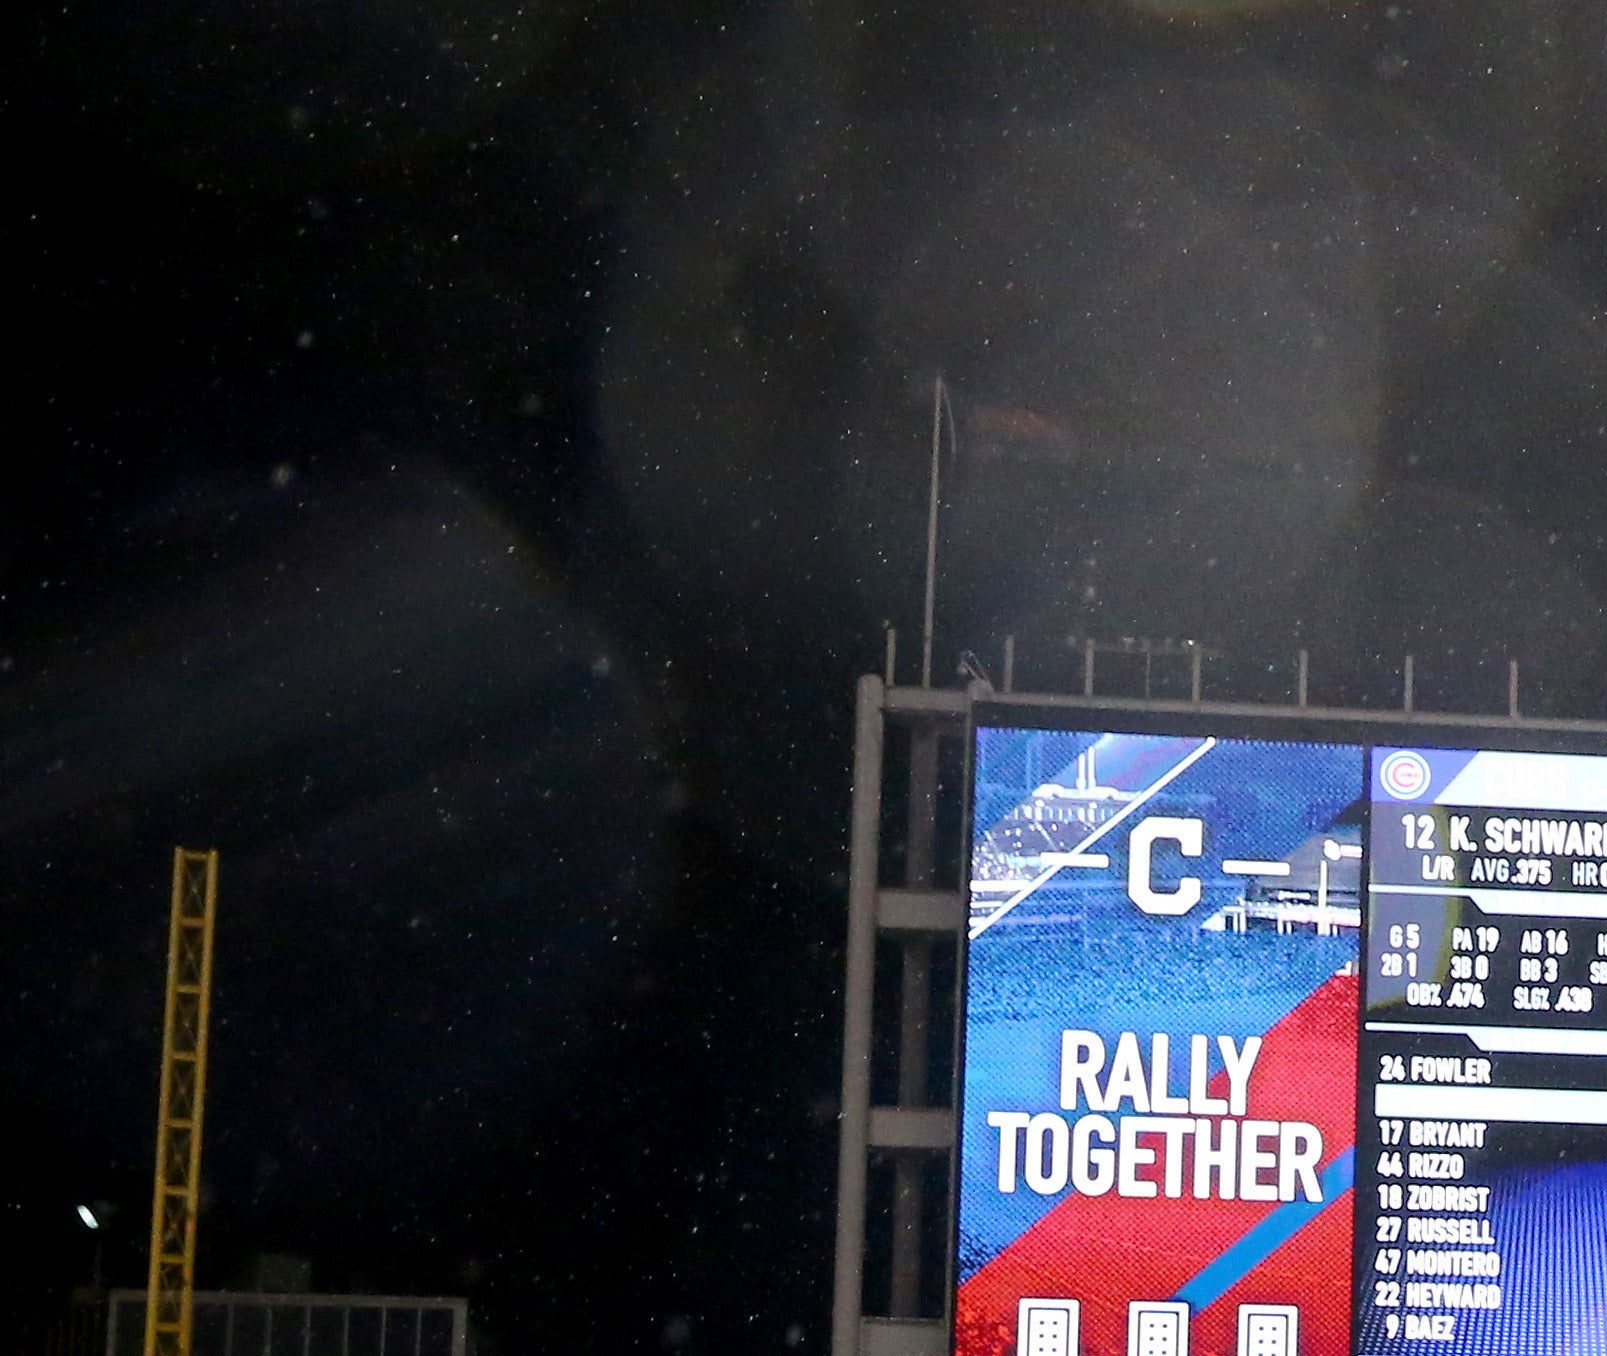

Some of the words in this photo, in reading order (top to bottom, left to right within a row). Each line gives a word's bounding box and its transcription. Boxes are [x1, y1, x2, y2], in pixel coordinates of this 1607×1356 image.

[1402, 814, 1435, 849] 12
[1451, 817, 1477, 851] K.
[1422, 855, 1454, 880] L/R
[1061, 1030, 1262, 1115] RALLY
[1381, 1056, 1405, 1080] 24
[1412, 1057, 1490, 1083] FOWLER
[1380, 1120, 1403, 1144] 17
[1410, 1121, 1486, 1147] BRYANT
[988, 1112, 1323, 1202] TOGETHER
[1378, 1152, 1403, 1176] 44
[1410, 1153, 1463, 1178] RIZZO
[1408, 1186, 1489, 1211] ZOBRIST
[1377, 1217, 1401, 1241] 27
[1408, 1218, 1494, 1244] RUSSELL
[1376, 1249, 1400, 1273] 47
[1407, 1250, 1499, 1277] MONTERO
[1376, 1282, 1399, 1306] 22
[1407, 1283, 1500, 1309] HEYWARD
[1387, 1315, 1398, 1338] 9
[1406, 1315, 1454, 1340] BAEZ
